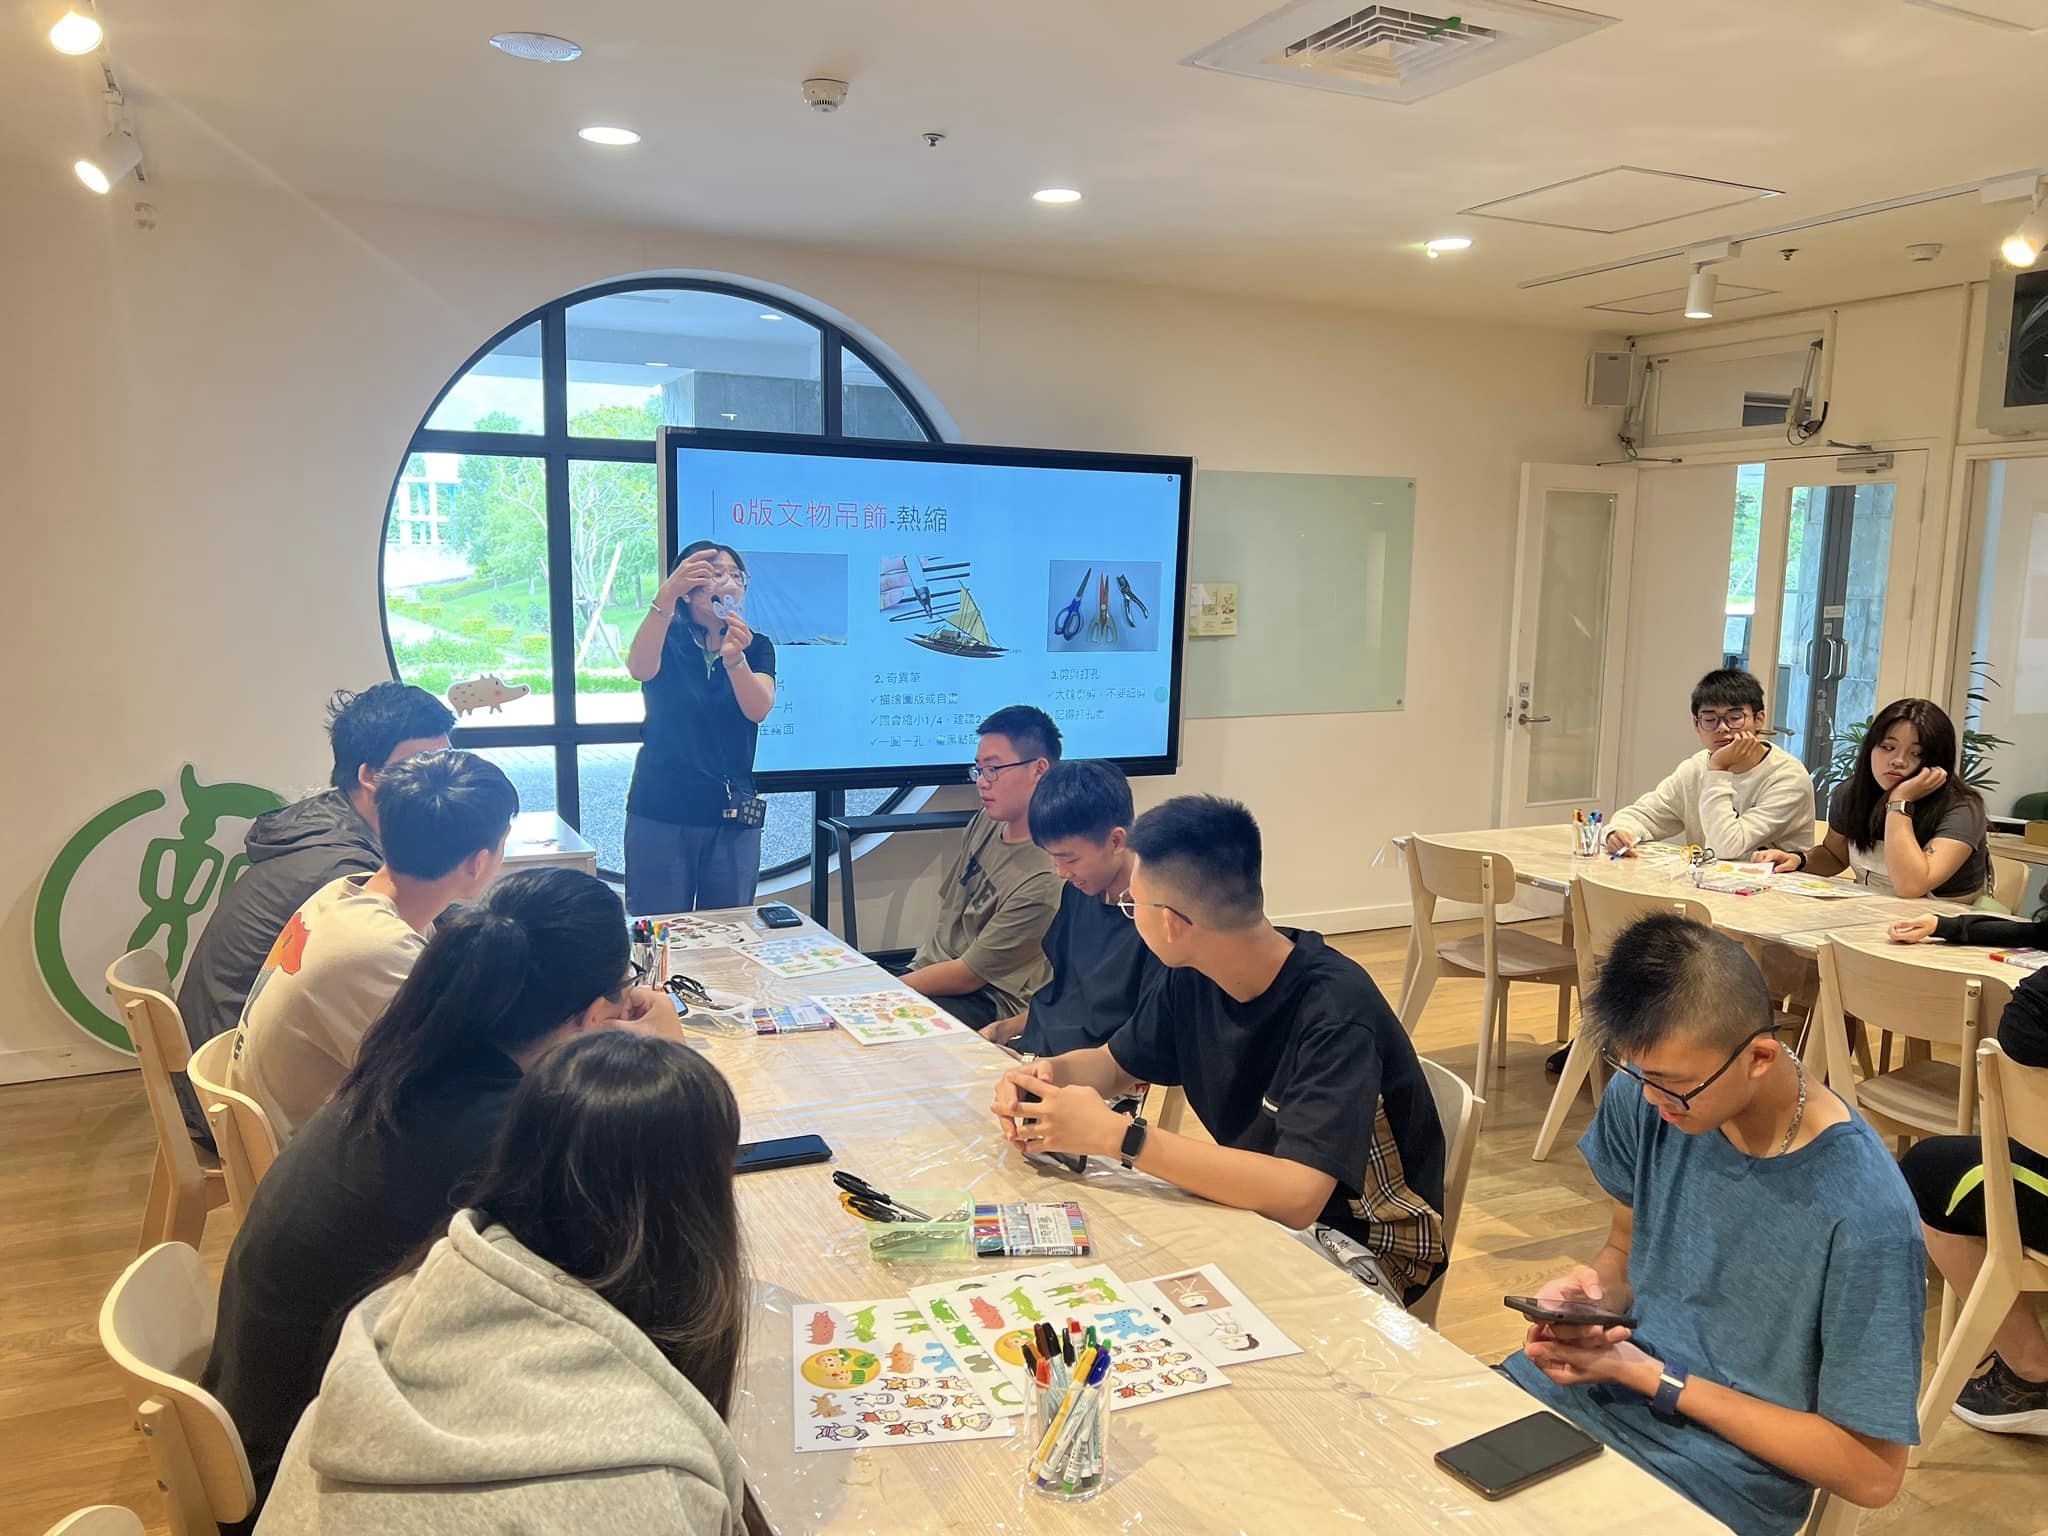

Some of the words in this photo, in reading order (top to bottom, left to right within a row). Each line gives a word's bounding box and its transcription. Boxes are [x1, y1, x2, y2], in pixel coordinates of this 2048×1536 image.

[732, 498, 948, 532] Q版文物吊飾-熱縮
